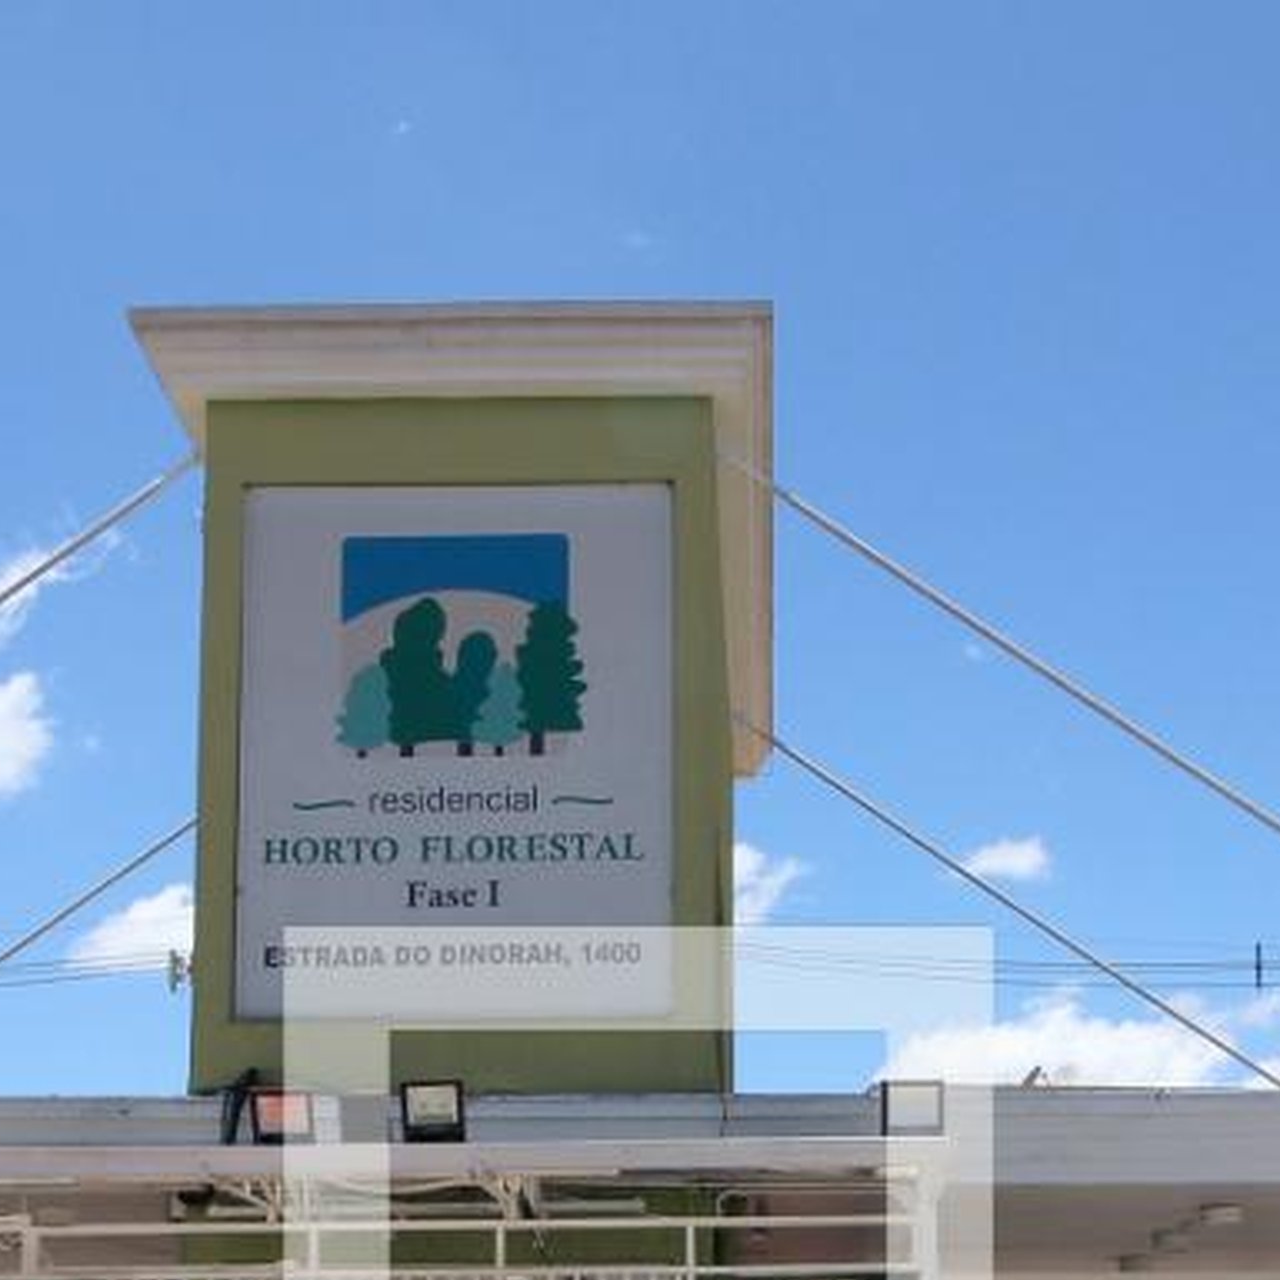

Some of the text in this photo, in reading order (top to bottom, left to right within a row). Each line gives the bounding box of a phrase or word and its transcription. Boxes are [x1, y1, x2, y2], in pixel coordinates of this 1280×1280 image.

[368, 785, 538, 814] residencial
[265, 833, 645, 865] HORTO FLORESTAL
[405, 879, 500, 907] Fase I
[264, 942, 642, 968] ESTRADA DO DINORAH, 1400
